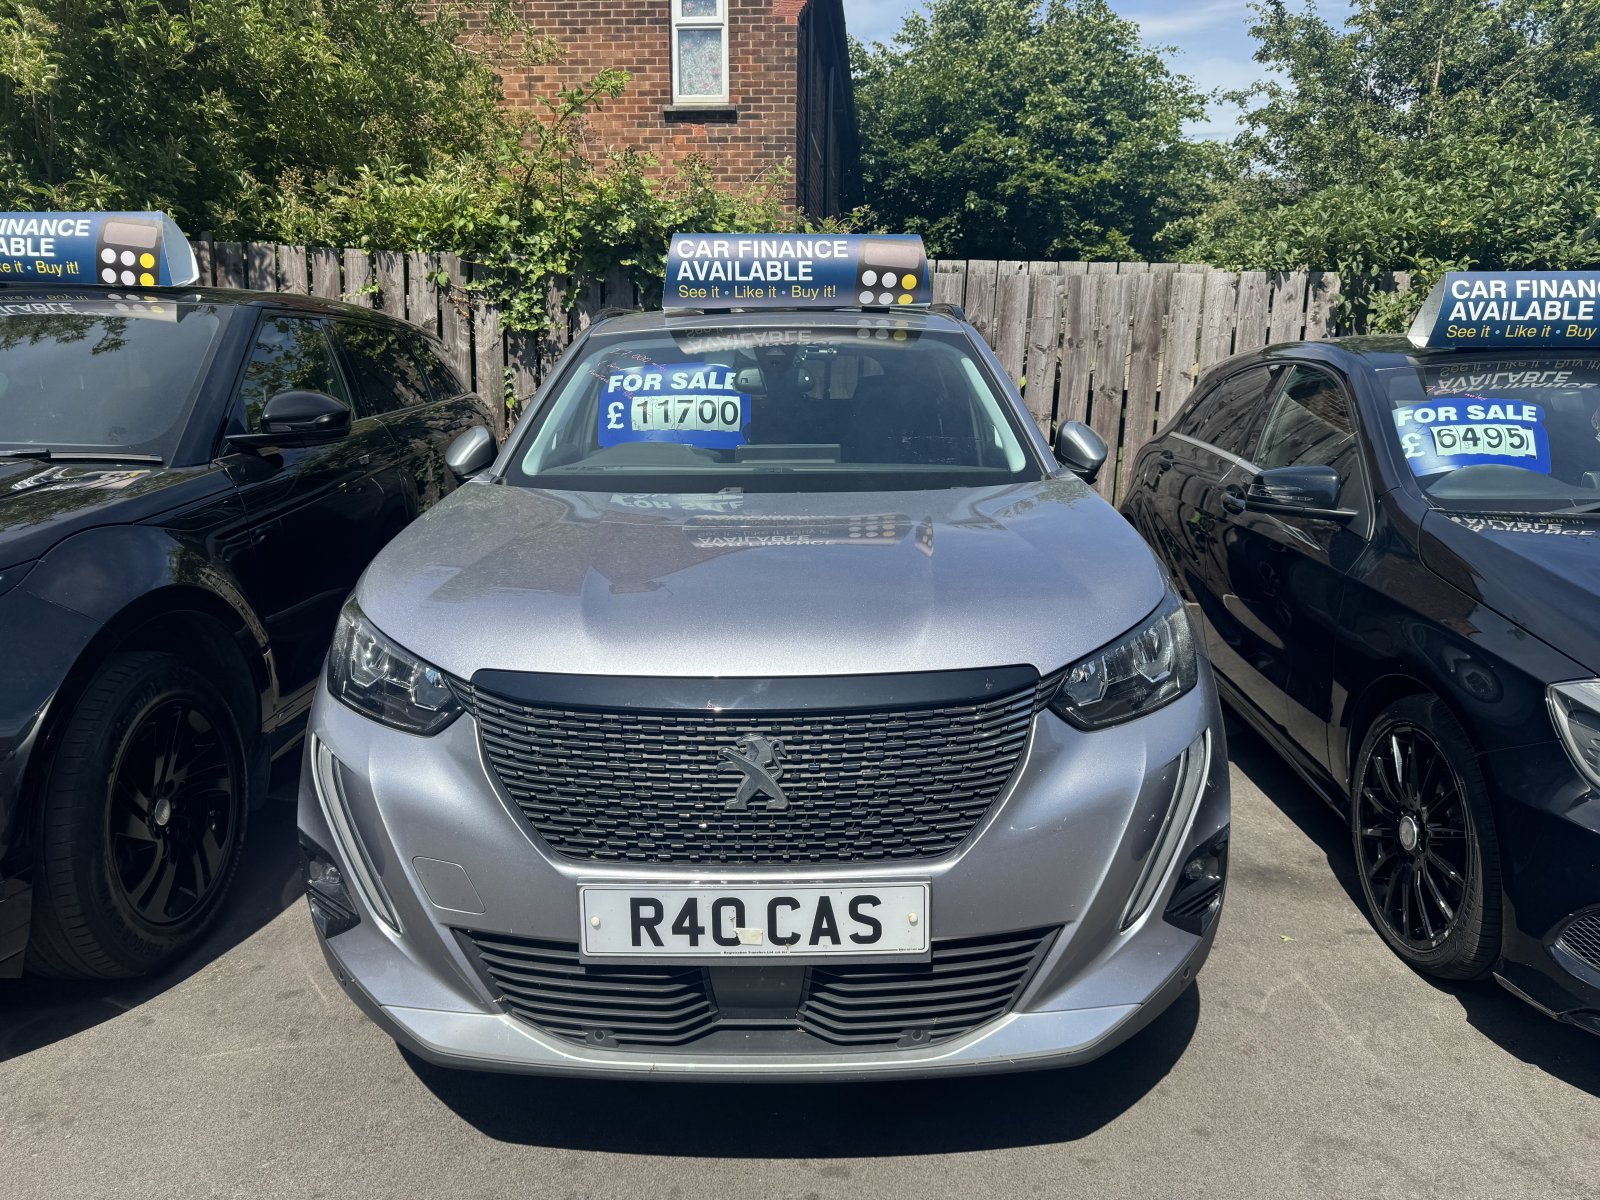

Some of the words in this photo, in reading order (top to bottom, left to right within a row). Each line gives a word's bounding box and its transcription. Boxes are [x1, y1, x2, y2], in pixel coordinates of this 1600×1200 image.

[0, 218, 91, 237] INANCE
[676, 239, 730, 258] CAR
[738, 239, 849, 258] FINANCE
[13, 259, 24, 273] it
[35, 260, 63, 277] Buy
[66, 260, 80, 274] it!
[676, 260, 813, 281] AVAILABLE
[678, 284, 707, 298] See
[711, 285, 720, 298] it
[734, 285, 764, 298] Like
[768, 285, 777, 298] it
[791, 285, 819, 300] Buy
[823, 285, 836, 298] it!
[1451, 279, 1507, 299] CAR
[1516, 279, 1600, 299] FINAN
[1448, 300, 1595, 321] AVAILABLE
[1446, 324, 1477, 338] See
[1480, 324, 1491, 338] it
[1505, 324, 1537, 338] Like
[1541, 324, 1552, 338] it
[1565, 324, 1598, 341] Buy
[607, 373, 663, 393] FOR
[607, 401, 625, 430] £
[636, 399, 739, 426] 11700
[1397, 407, 1458, 427] FOR
[1467, 404, 1538, 422] SALE
[1402, 433, 1426, 459] £
[1436, 427, 1526, 450] 6495
[629, 896, 746, 947] R40
[766, 894, 882, 946] CAS
